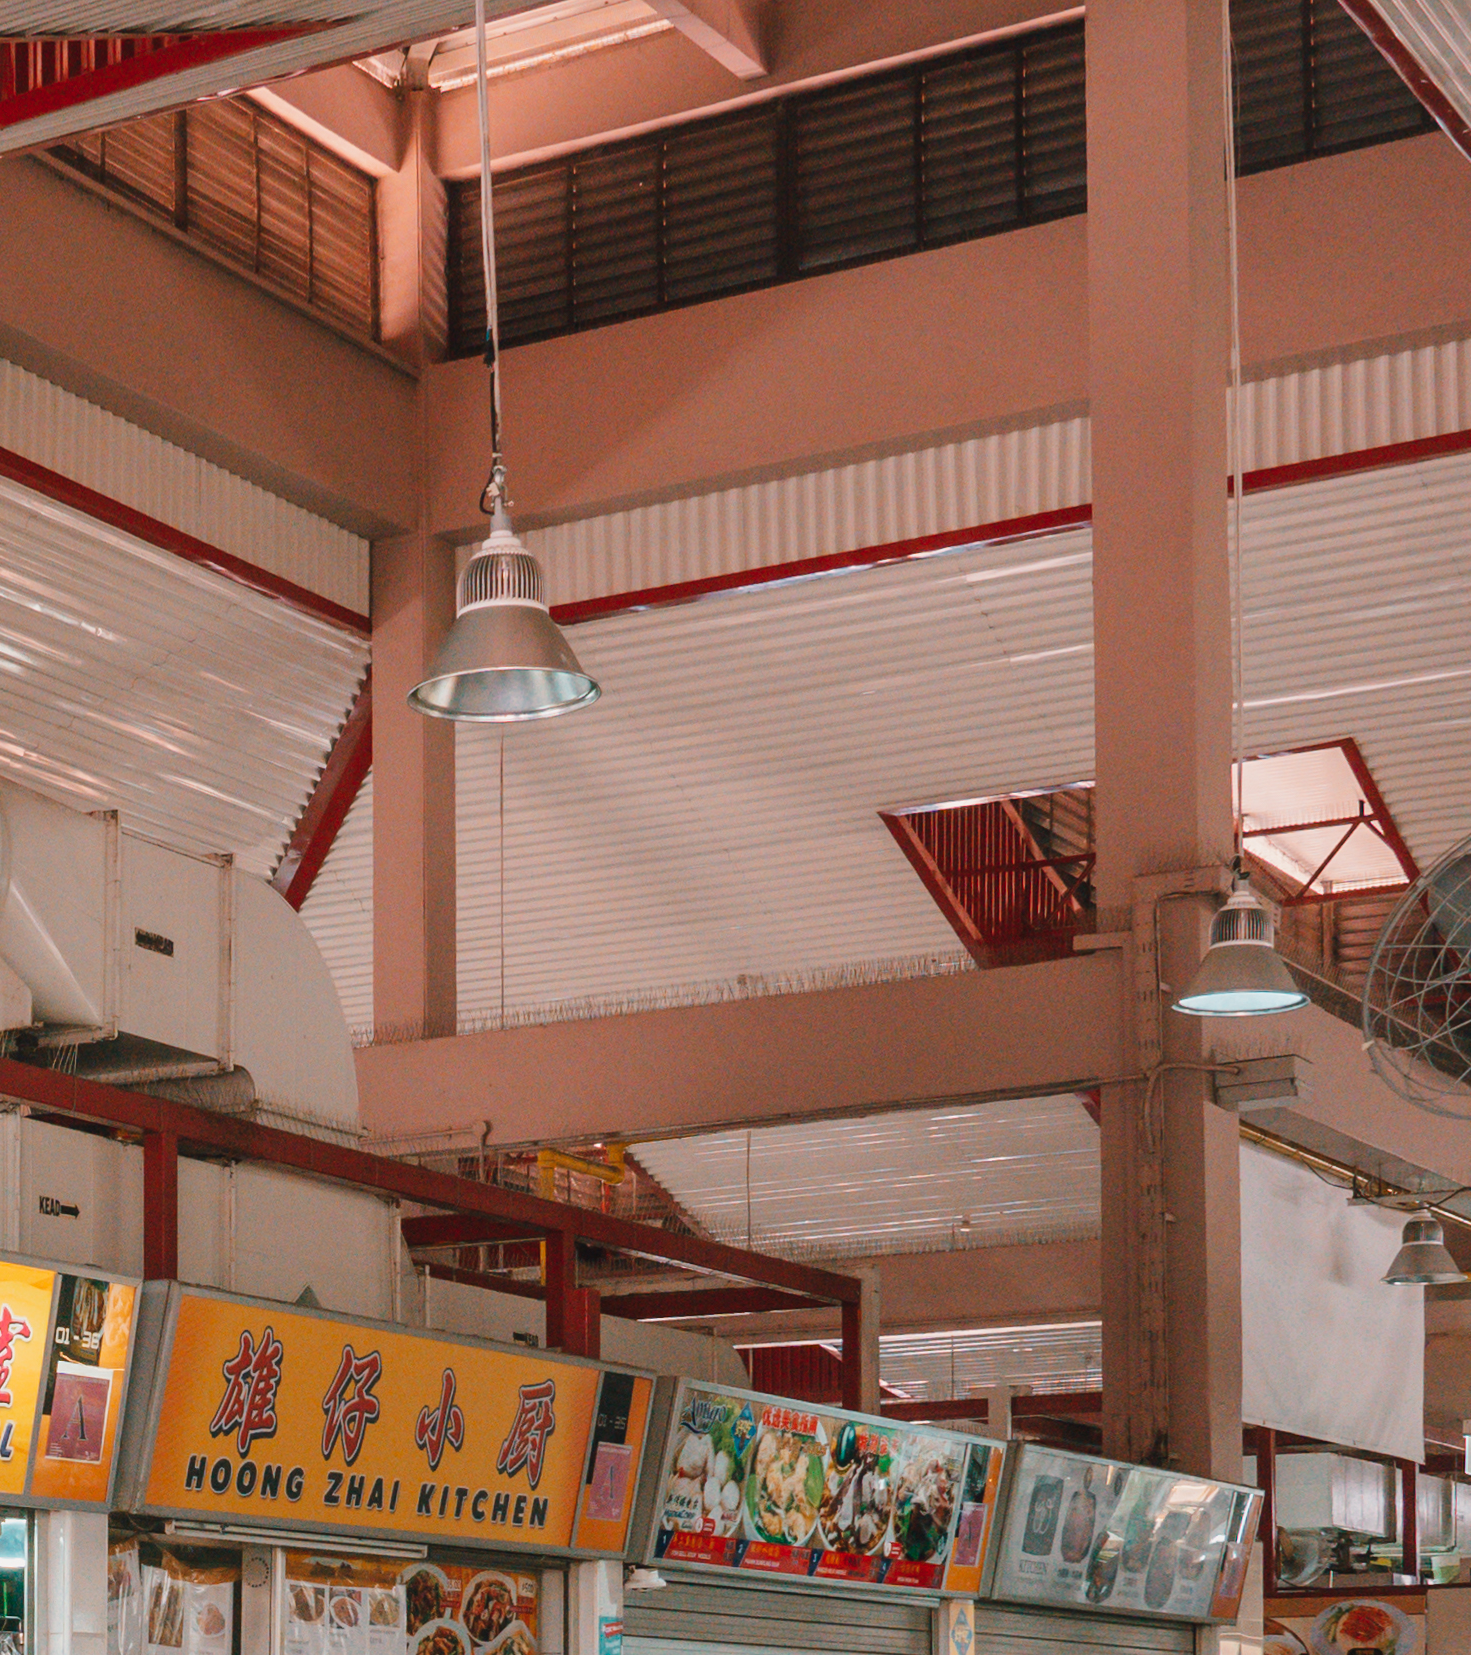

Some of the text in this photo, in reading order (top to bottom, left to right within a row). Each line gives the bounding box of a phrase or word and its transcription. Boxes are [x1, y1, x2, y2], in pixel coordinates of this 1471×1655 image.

[39, 1196, 60, 1217] KEAD
[61, 1394, 89, 1441] A
[210, 1325, 556, 1492] 雄仔小厨
[184, 1453, 549, 1529] HOONG ZHAI KITCHEN
